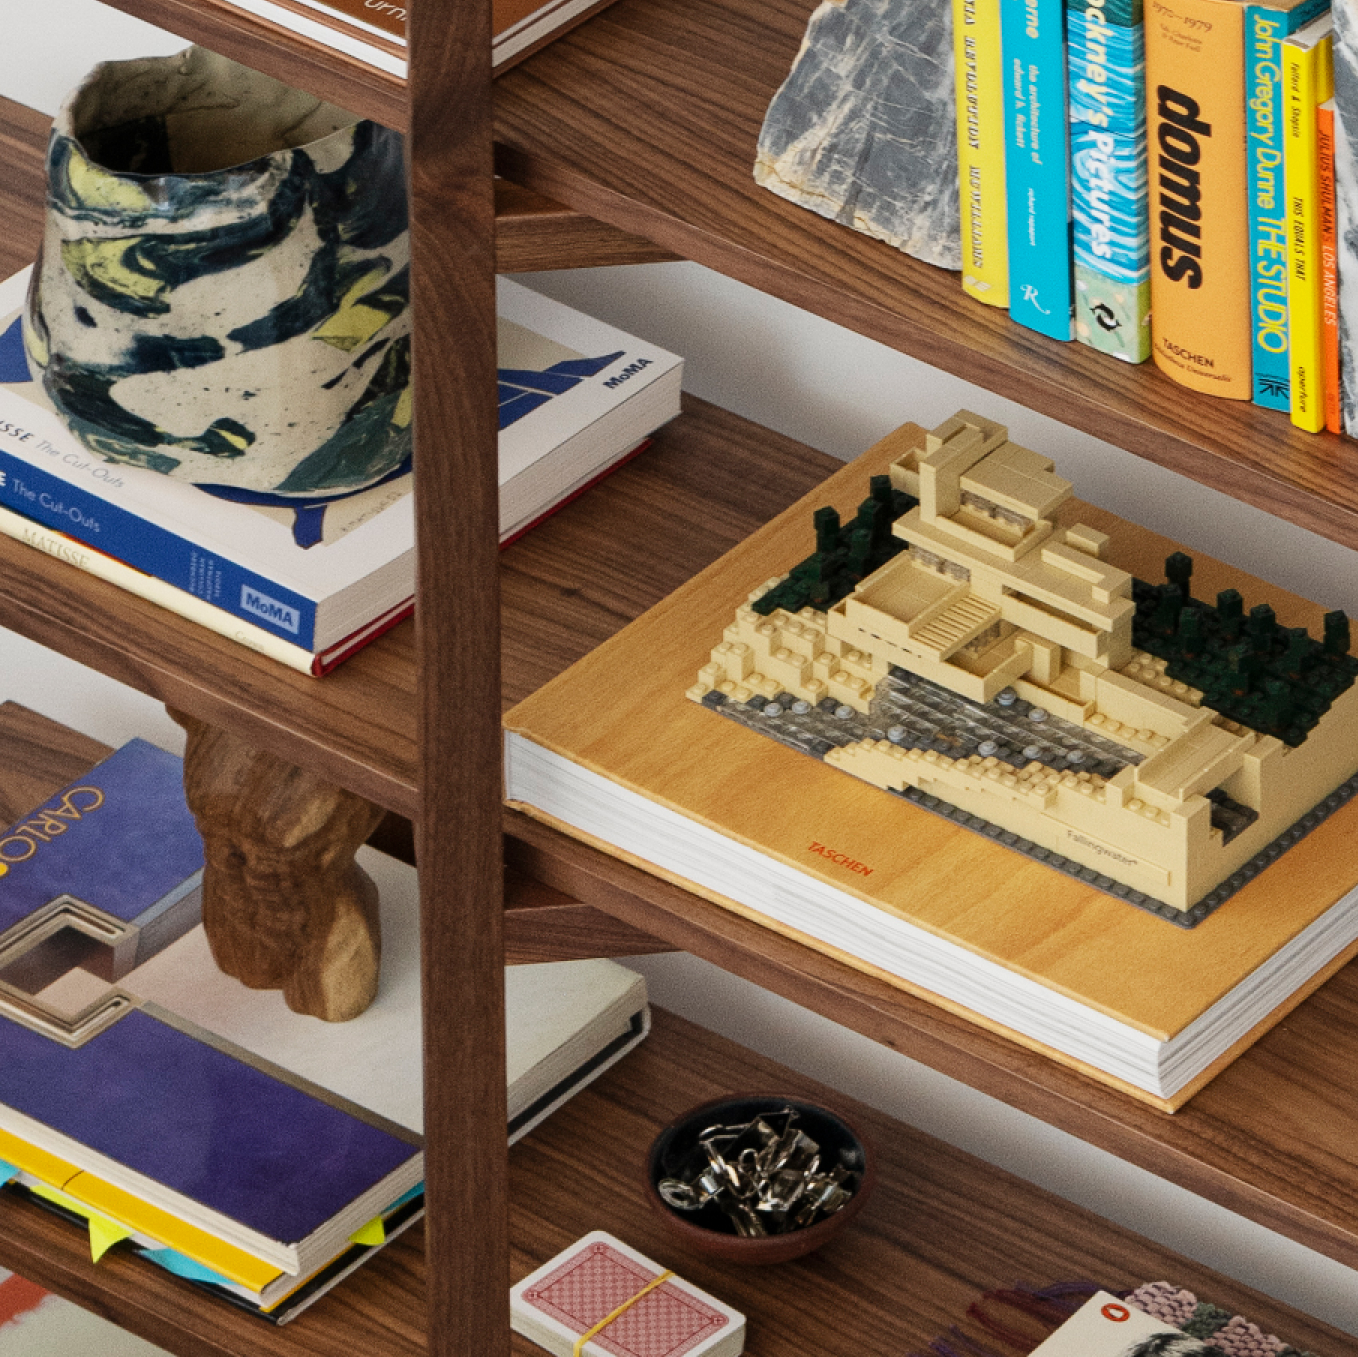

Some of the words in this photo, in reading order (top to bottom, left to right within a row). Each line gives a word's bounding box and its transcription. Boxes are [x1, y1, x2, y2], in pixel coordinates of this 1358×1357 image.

[1253, 14, 1282, 60] John
[963, 35, 981, 150] REVOLUTION
[1028, 64, 1041, 83] the
[1028, 84, 1042, 151] architecture
[1250, 60, 1282, 146] Gregory
[1319, 130, 1331, 173] JULIUS
[1087, 130, 1115, 260] Pictures
[1157, 84, 1213, 291] domus
[1256, 147, 1282, 209] Dunne
[1293, 196, 1304, 217] THIS
[1257, 216, 1287, 262] THE
[1293, 217, 1306, 256] EQUALS
[1322, 245, 1335, 268] LOS
[1295, 257, 1306, 282] THAT
[1257, 259, 1288, 354] STUDIO
[1323, 269, 1337, 326] ANGELES
[602, 357, 654, 390] MoMA
[1162, 336, 1215, 368] TASCHEN
[1298, 366, 1309, 413] aperture
[0, 420, 35, 443] SSE
[35, 439, 61, 457] The
[62, 453, 126, 488] Cut-Outs
[12, 478, 37, 501] The
[39, 492, 101, 533] Cut-Outs
[22, 528, 91, 568] MATISSE
[246, 591, 294, 627] MoMA
[0, 785, 106, 863] CARLO
[806, 840, 875, 878] TASCHEN
